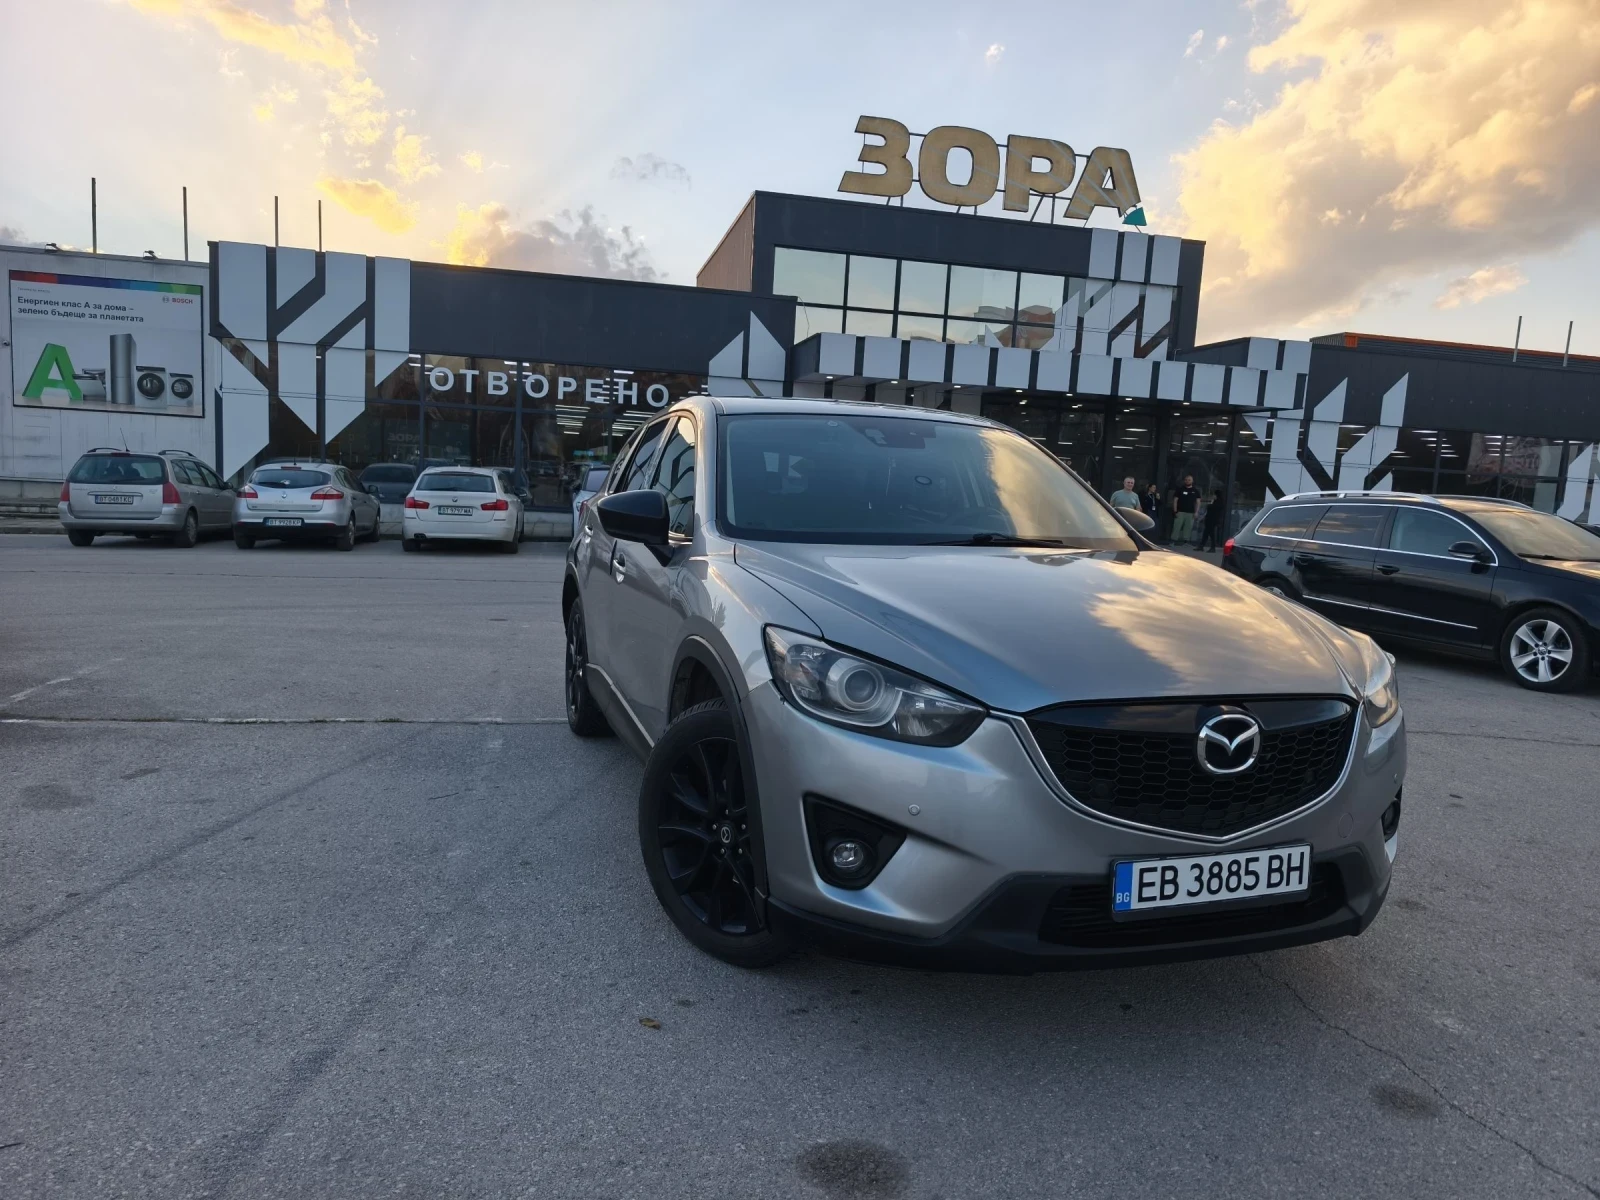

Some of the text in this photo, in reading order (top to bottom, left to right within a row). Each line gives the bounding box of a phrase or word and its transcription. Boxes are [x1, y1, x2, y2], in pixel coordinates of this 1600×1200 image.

[838, 115, 1144, 221] ЗОРА
[17, 296, 60, 306] Енергиен
[61, 300, 82, 308] клас
[83, 301, 90, 309] А
[103, 304, 127, 312] дома
[17, 307, 49, 315] зелено
[50, 308, 86, 318] бъдеще
[99, 313, 144, 322] планетата
[429, 366, 669, 408] ОТВОРЕНО
[1137, 851, 1305, 903] EB 3885 BH
[1115, 892, 1130, 904] BG
